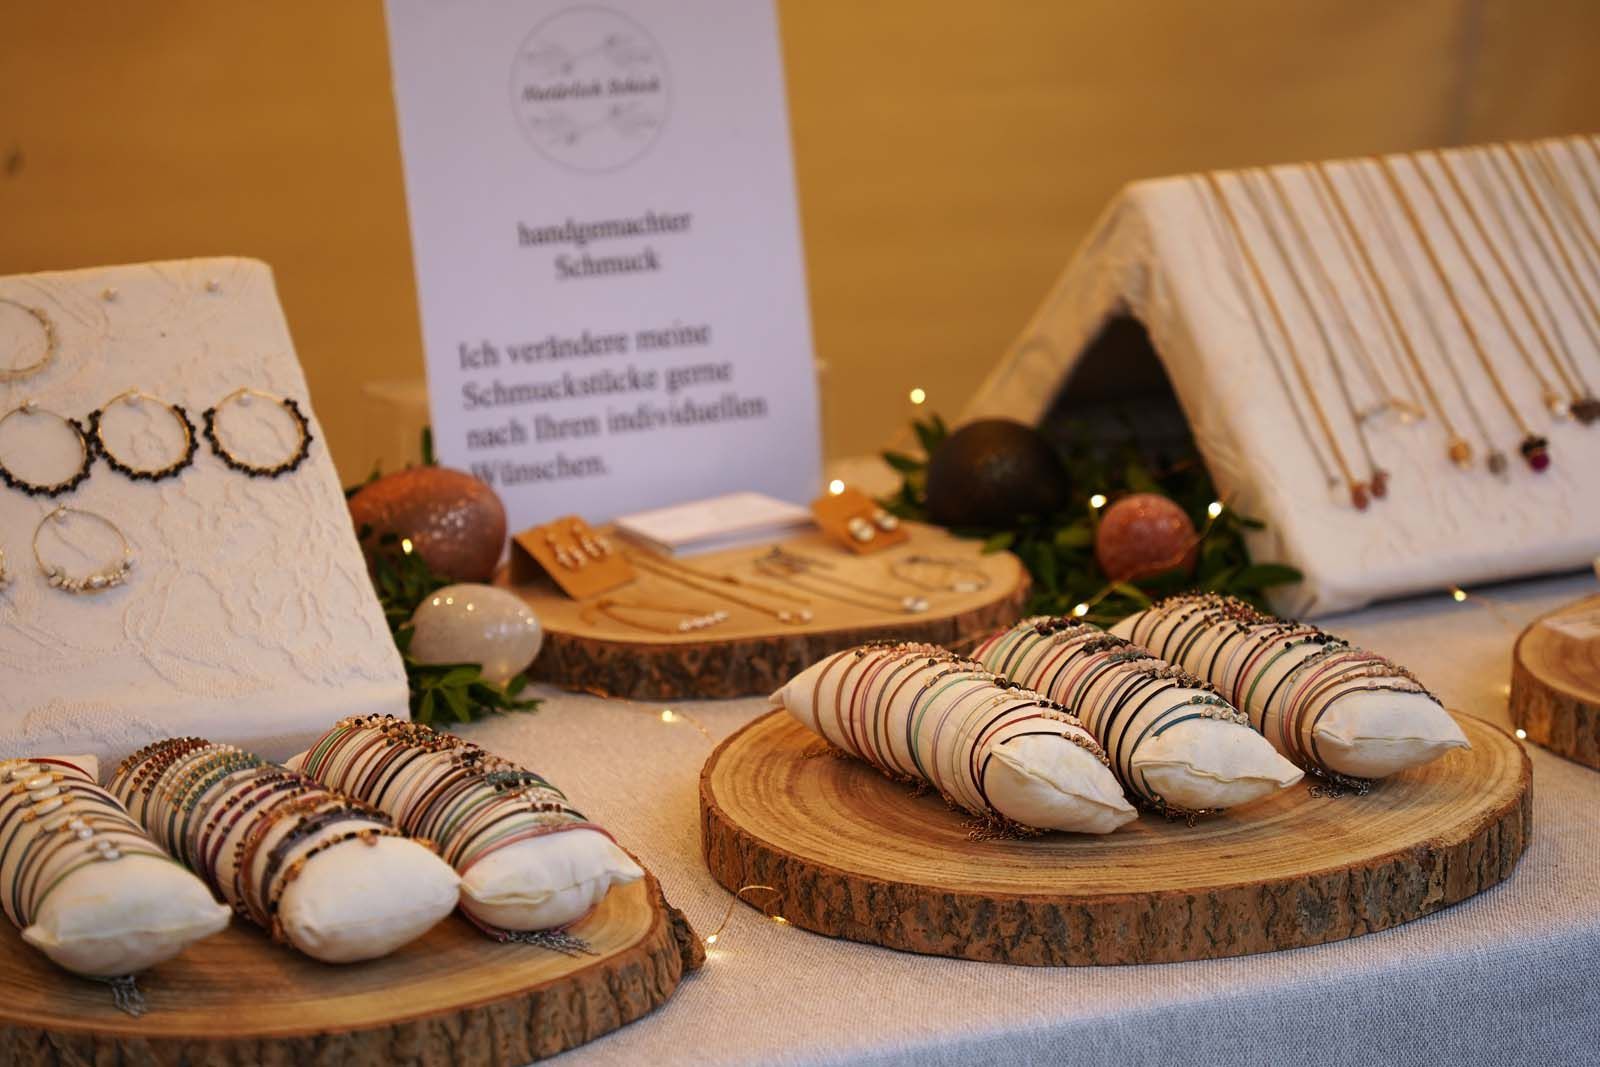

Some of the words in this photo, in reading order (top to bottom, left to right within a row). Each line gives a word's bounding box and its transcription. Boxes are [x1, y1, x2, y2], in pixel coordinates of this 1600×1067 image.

[517, 208, 692, 249] handgemachter
[554, 247, 661, 281] Schmuck
[459, 341, 500, 370] Ich
[506, 330, 629, 365] verändere
[636, 320, 711, 349] meine
[462, 366, 658, 410] Schmuckstücke
[665, 361, 733, 392] gerne
[467, 420, 527, 449] nach
[534, 411, 601, 443] Ihren
[607, 393, 768, 436] individuellen
